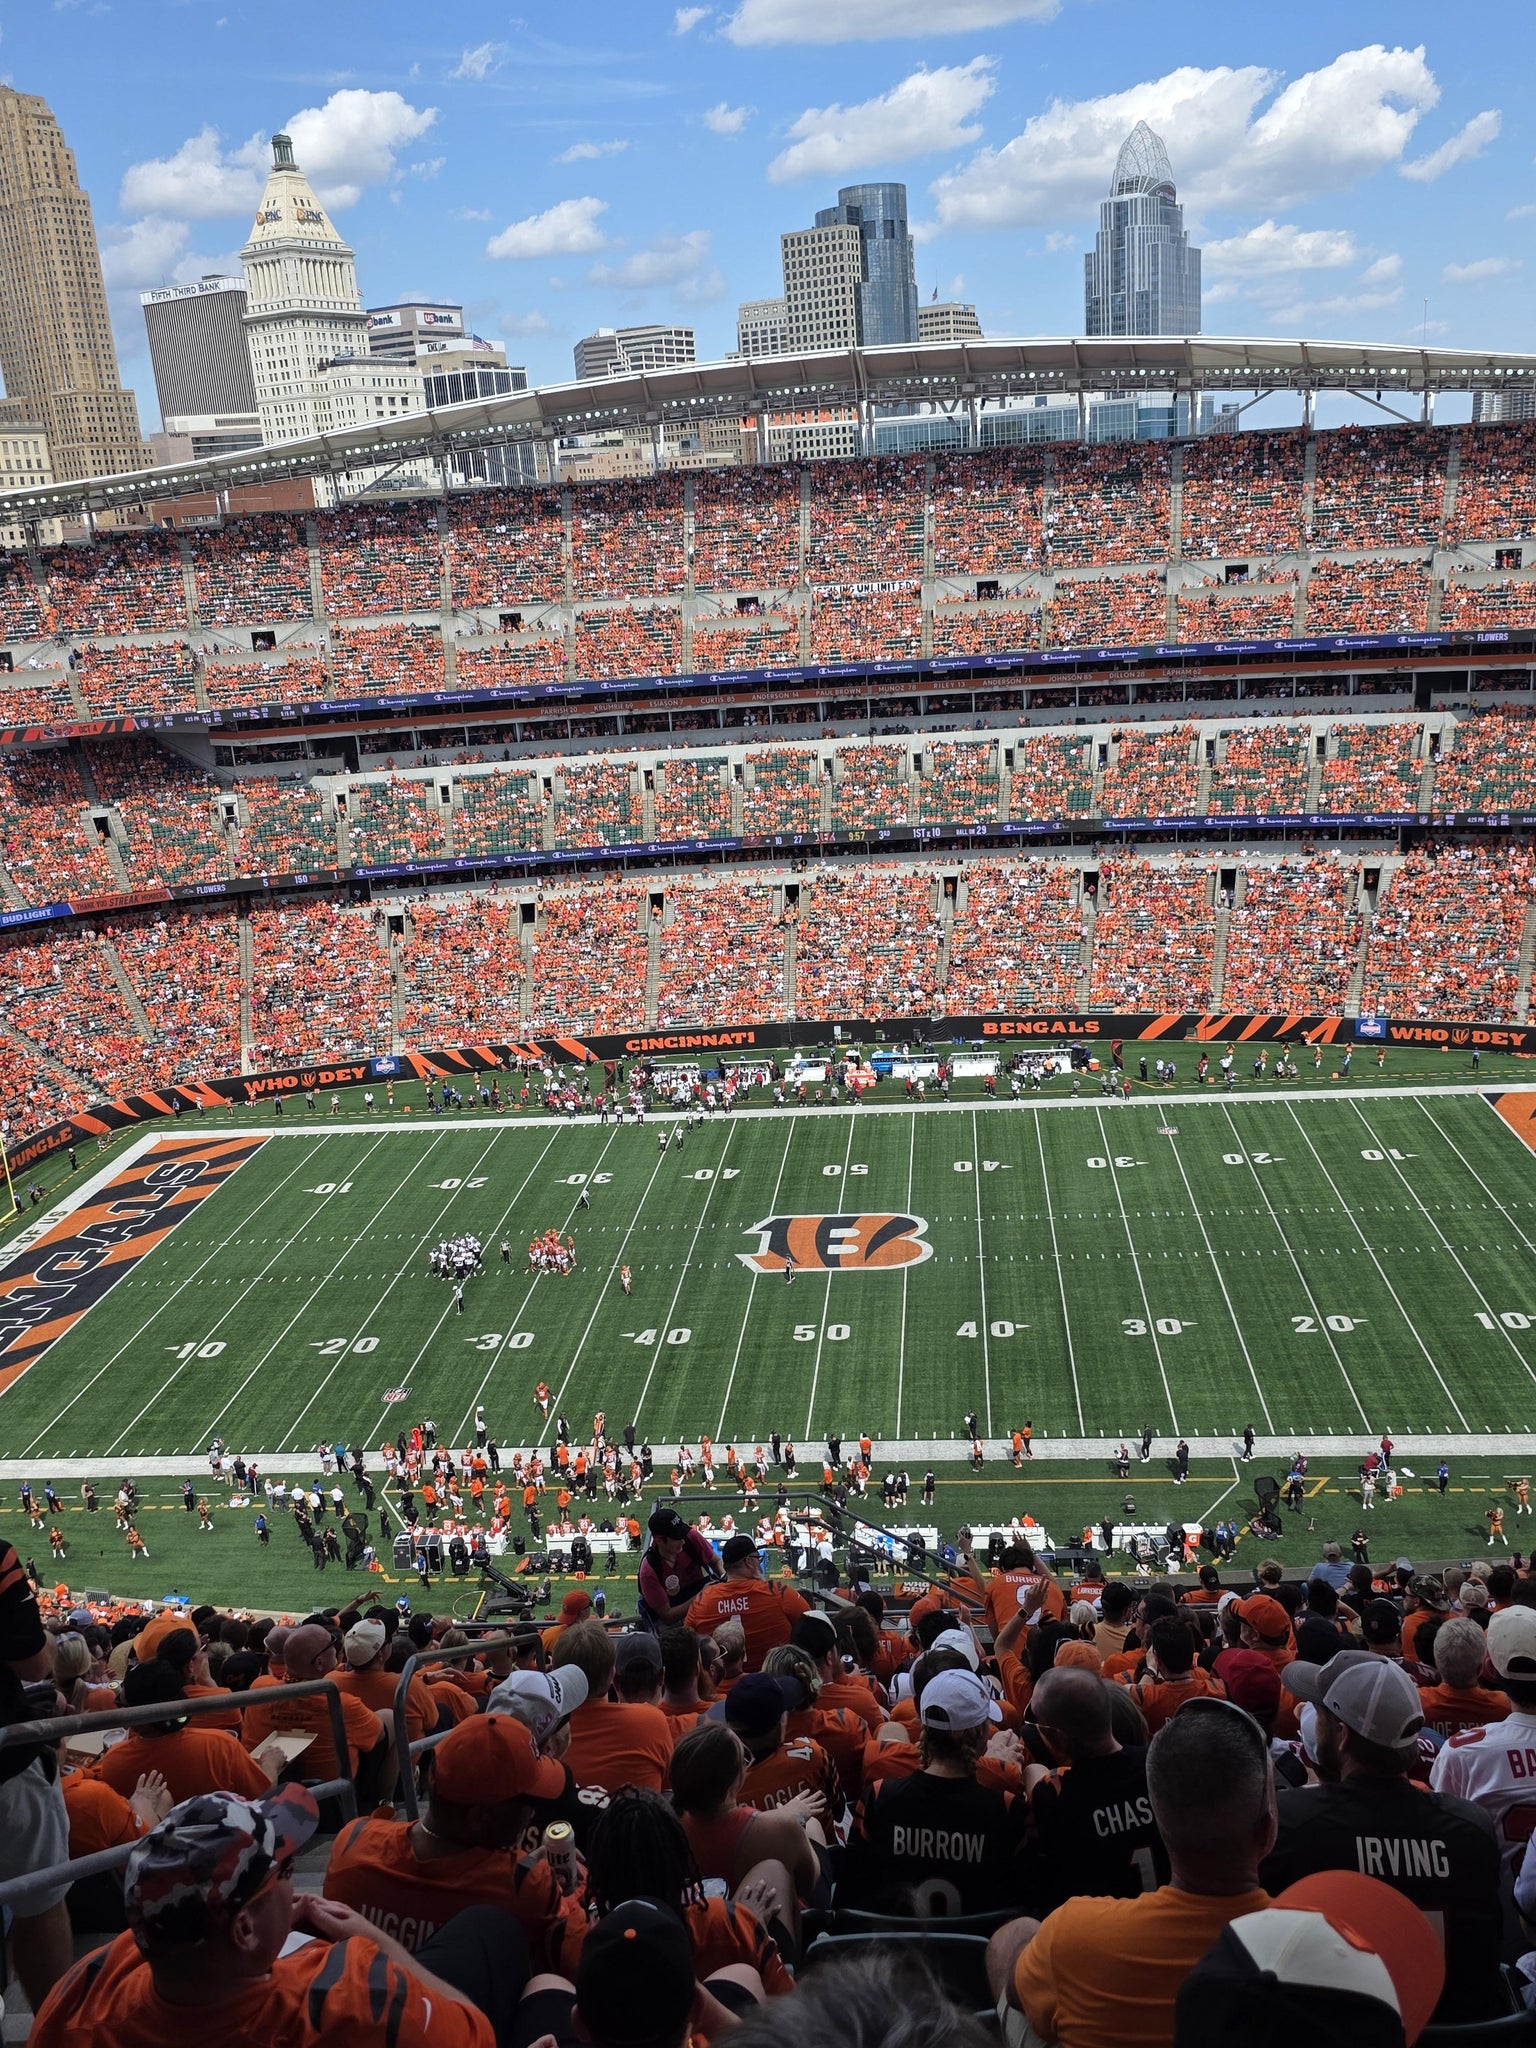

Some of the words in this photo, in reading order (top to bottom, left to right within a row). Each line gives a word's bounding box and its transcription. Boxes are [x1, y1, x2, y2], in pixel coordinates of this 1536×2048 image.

[264, 210, 282, 220] PNC
[306, 210, 323, 221] PNC
[151, 290, 172, 301] FIFTH
[174, 286, 196, 299] THIRD
[198, 282, 220, 292] BANK
[1398, 636, 1442, 644] Champion
[1477, 633, 1508, 642] FLOWERS
[1215, 644, 1256, 652] Champion
[1274, 641, 1317, 649] Champion
[1098, 650, 1138, 658] Champion
[1156, 647, 1197, 655] Champion
[985, 657, 1024, 665] Champion
[1041, 653, 1081, 661] Champion
[929, 660, 968, 668] Champion
[764, 671, 802, 679] Champion
[819, 667, 857, 675] Champion
[655, 678, 694, 686] Champion
[710, 674, 748, 682] Champion
[1048, 675, 1082, 683] JOHNSON
[546, 686, 584, 694] Champion
[601, 682, 639, 690] Champion
[490, 690, 530, 698] Champion
[378, 698, 418, 706] Champion
[1153, 819, 1197, 827] Champion
[1204, 818, 1249, 826] Champion
[1257, 817, 1302, 825] Champion
[1310, 816, 1356, 824] Champion
[1364, 815, 1410, 824] Champion
[976, 825, 986, 835] 29
[1003, 824, 1045, 832] Champion
[848, 832, 865, 841] 9:57
[879, 830, 890, 839] 3RD
[913, 829, 926, 838] 1ST
[932, 828, 940, 836] 10
[696, 841, 736, 849] Champion
[775, 837, 782, 845] 10
[794, 836, 802, 844] 27
[601, 848, 641, 856] Champion
[648, 844, 688, 852] Champion
[504, 855, 546, 863] Champion
[552, 851, 594, 859] Champion
[406, 863, 448, 871] Champion
[455, 859, 497, 867] Champion
[356, 868, 399, 876] Champion
[196, 884, 226, 894] FLOWERS
[263, 879, 268, 887] 5
[294, 875, 308, 885] 150
[109, 894, 139, 907] STREAK
[2, 914, 23, 924] BUD
[23, 908, 52, 920] LIGHT
[982, 1020, 1100, 1035] BENGALS
[1390, 1027, 1449, 1041] WHO
[1472, 1030, 1527, 1046] DEY
[625, 1031, 755, 1052] CINCINNATI
[243, 1075, 298, 1093] WHO
[318, 1066, 366, 1084] DEY
[9, 1126, 73, 1172] JUNGLE
[38, 1210, 69, 1224] US
[1291, 1315, 1356, 1333] 20
[1474, 1312, 1532, 1330] 10
[956, 1320, 1015, 1338] 40
[1121, 1318, 1183, 1335] 30
[633, 1328, 692, 1345] 40
[792, 1324, 851, 1341] 50
[476, 1332, 535, 1349] 30
[176, 1341, 227, 1359] 10
[318, 1337, 381, 1355] 20
[575, 1572, 583, 1580] 40
[1005, 1575, 1042, 1584] BURRO
[718, 1597, 749, 1613] CHASE
[1092, 1796, 1154, 1837] CHAS
[893, 1824, 985, 1864] BURROW
[1356, 1835, 1450, 1878] IRVING
